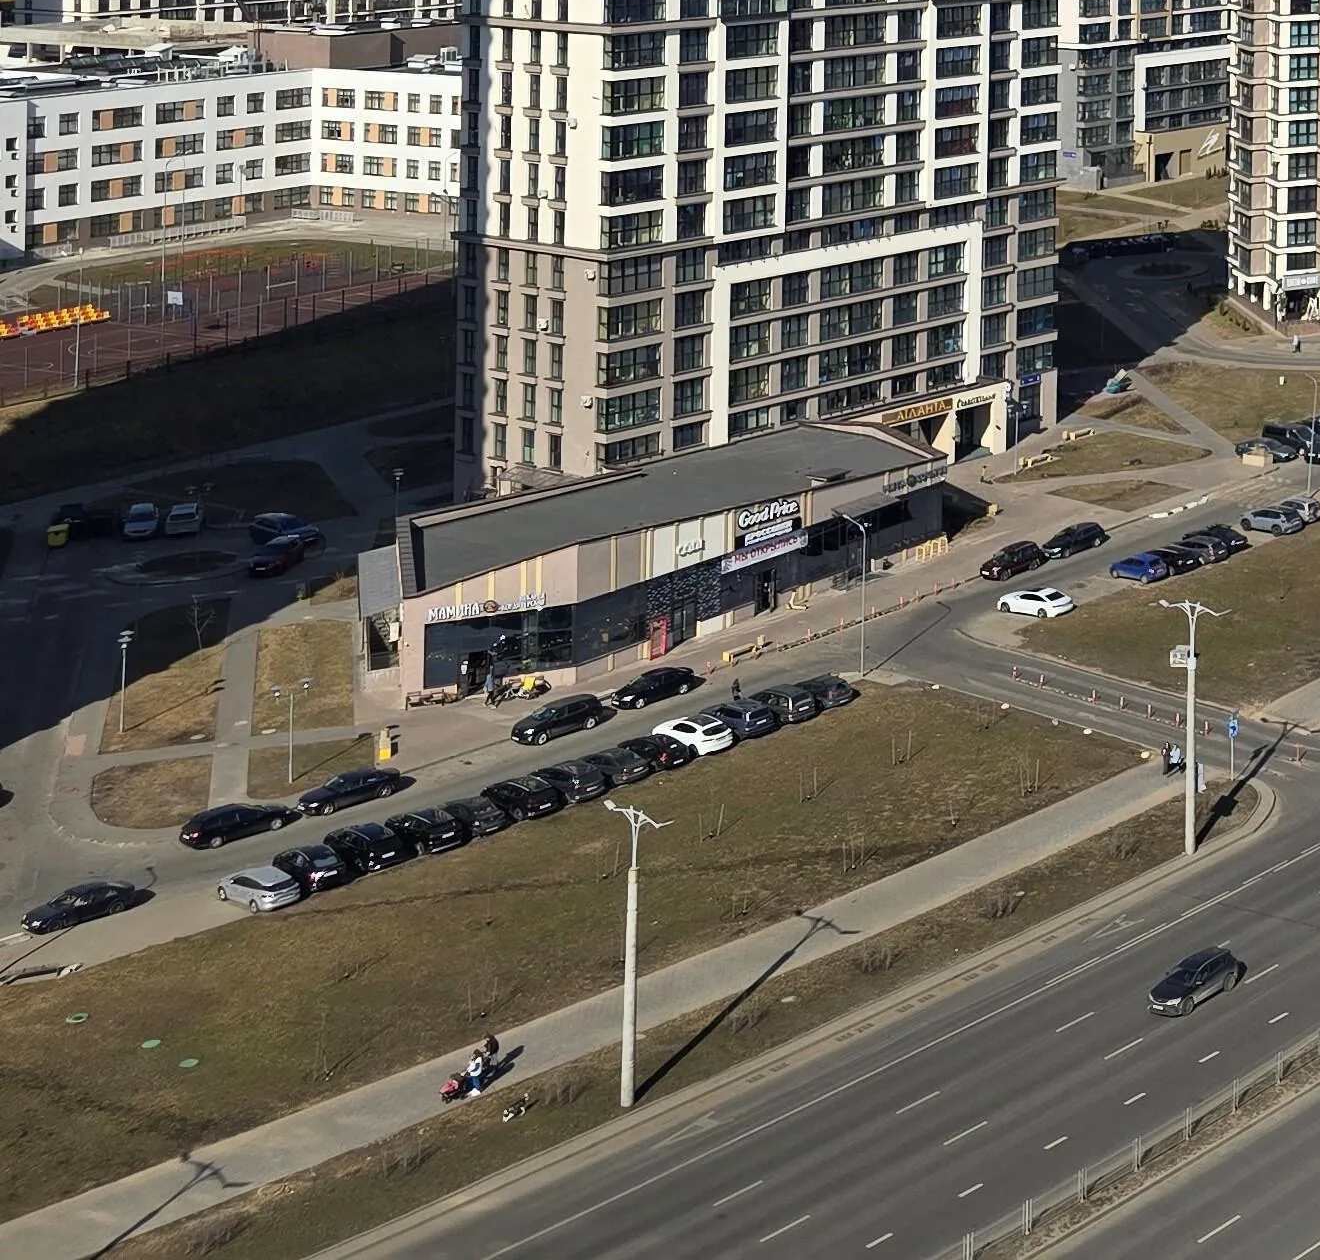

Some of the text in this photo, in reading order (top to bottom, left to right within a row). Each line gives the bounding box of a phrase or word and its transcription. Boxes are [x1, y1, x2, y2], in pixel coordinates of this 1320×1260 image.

[897, 400, 946, 421] АТЛАНТА
[738, 501, 799, 528] Good Price
[428, 602, 480, 621] МАМИНА
